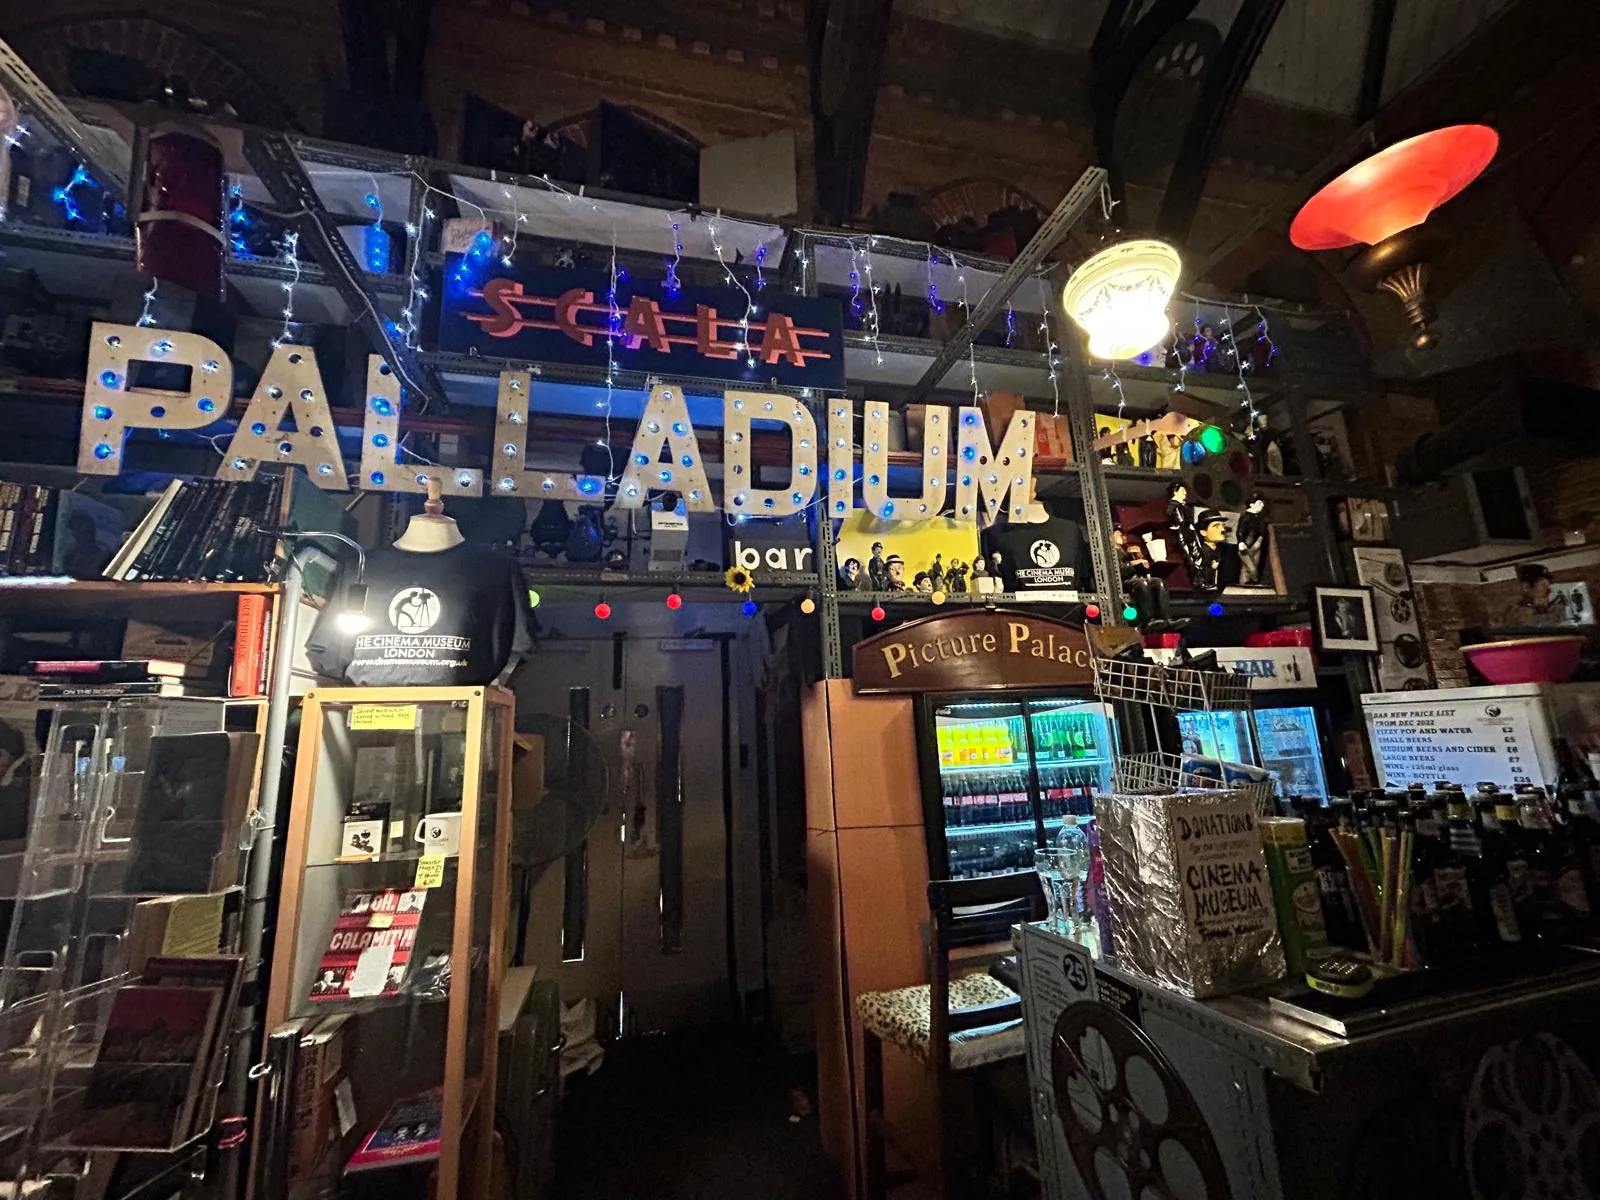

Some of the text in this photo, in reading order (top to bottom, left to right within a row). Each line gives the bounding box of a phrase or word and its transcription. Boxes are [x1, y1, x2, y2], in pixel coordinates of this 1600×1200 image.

[480, 278, 806, 367] SCALA
[77, 322, 1036, 525] PALLADIUM
[735, 541, 813, 570] bar
[372, 637, 420, 647] CINEMA
[421, 637, 471, 649] MUSEUM
[384, 649, 436, 659] LONDON
[881, 633, 996, 679] Picture
[1235, 658, 1276, 678] BAR
[1438, 764, 1460, 772] glass
[1186, 860, 1262, 890] CINEMA
[1193, 886, 1263, 919] MUSEUM
[1065, 957, 1087, 988] 25
